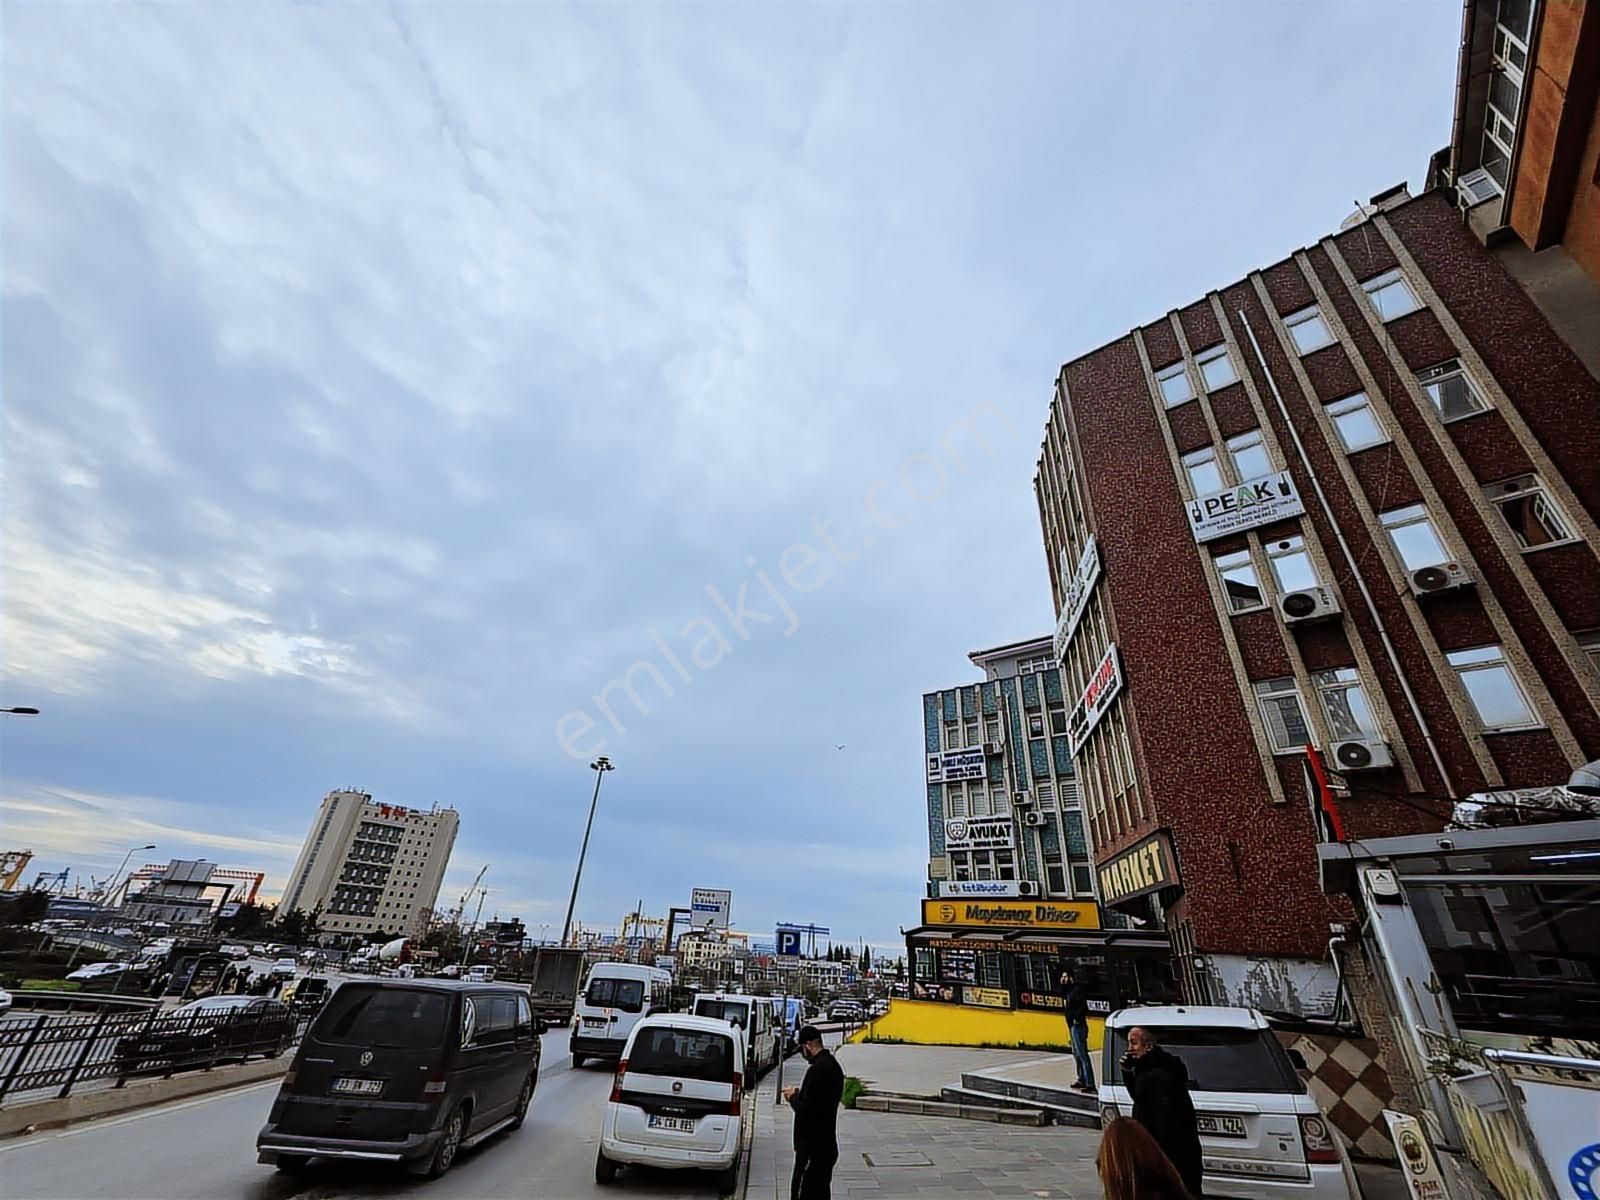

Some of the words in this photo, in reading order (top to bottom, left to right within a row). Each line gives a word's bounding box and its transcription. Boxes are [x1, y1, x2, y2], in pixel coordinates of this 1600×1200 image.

[1204, 480, 1274, 516] PEAK
[969, 824, 1012, 840] AVUKAT
[1100, 840, 1165, 903] MARKET
[1035, 904, 1080, 923] Döner
[783, 934, 795, 953] P
[1222, 1118, 1243, 1133] 424
